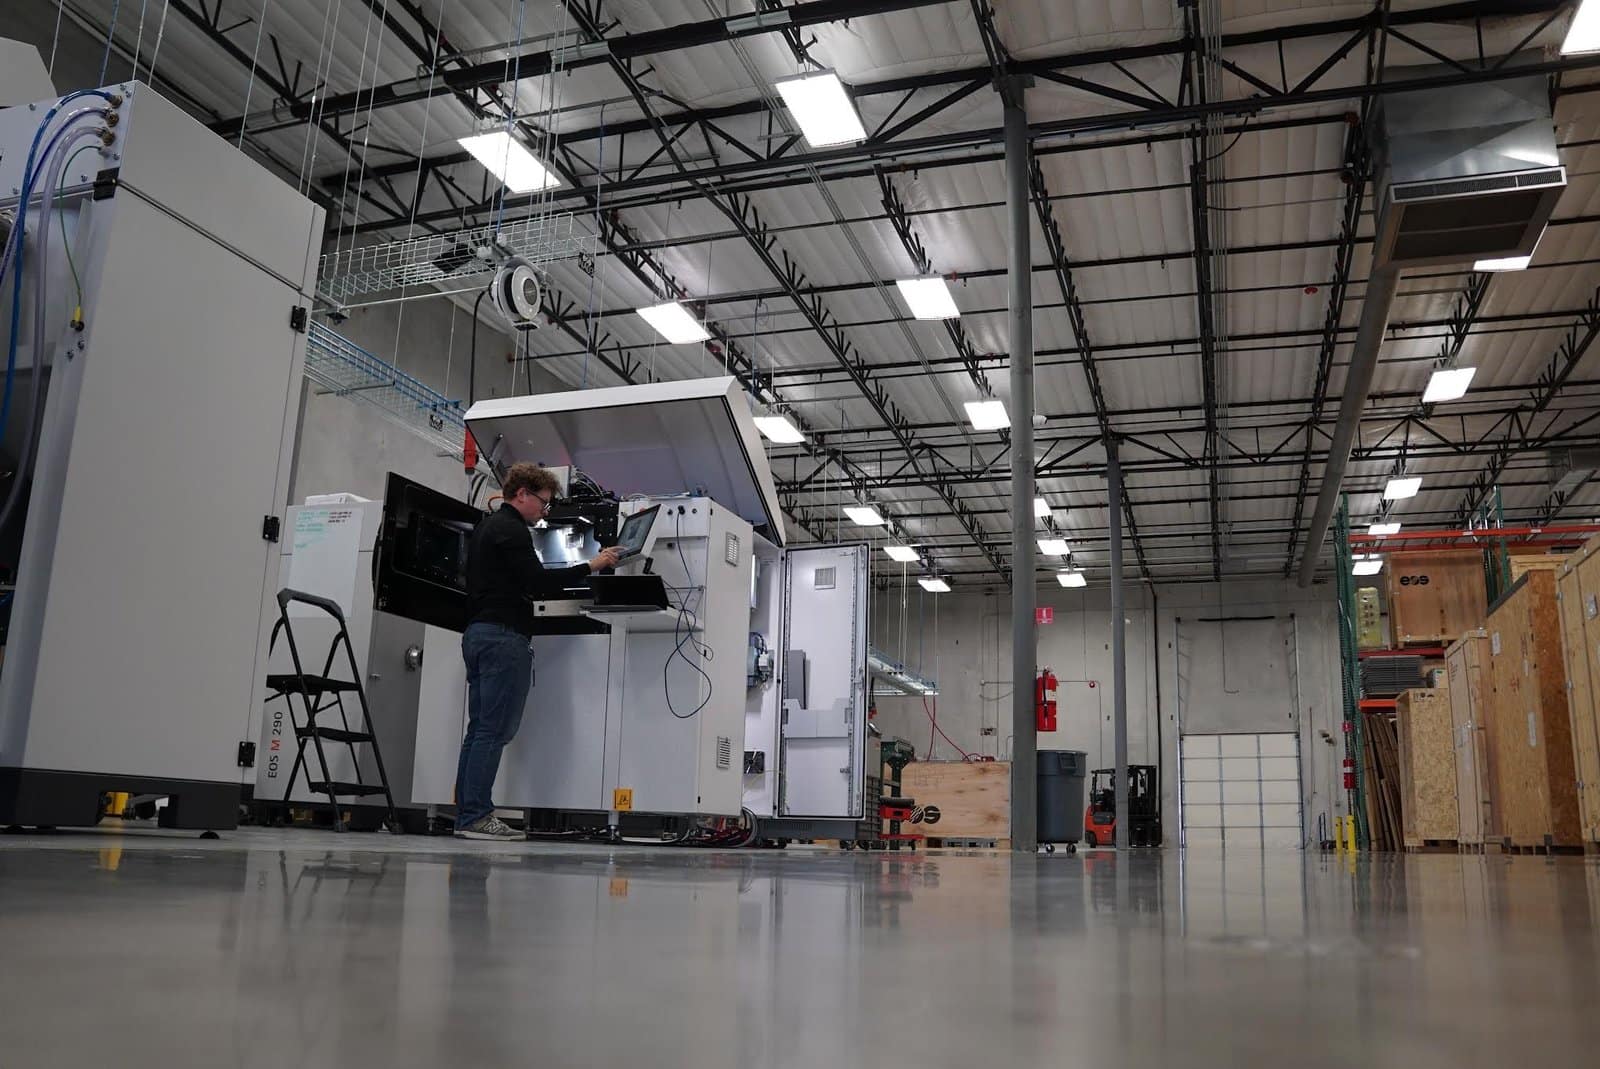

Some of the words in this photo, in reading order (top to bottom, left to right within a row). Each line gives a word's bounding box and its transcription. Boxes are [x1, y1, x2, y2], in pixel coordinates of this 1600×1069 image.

[1400, 575, 1429, 586] eos
[272, 711, 283, 736] 290
[271, 740, 281, 751] M
[268, 755, 279, 779] EOS
